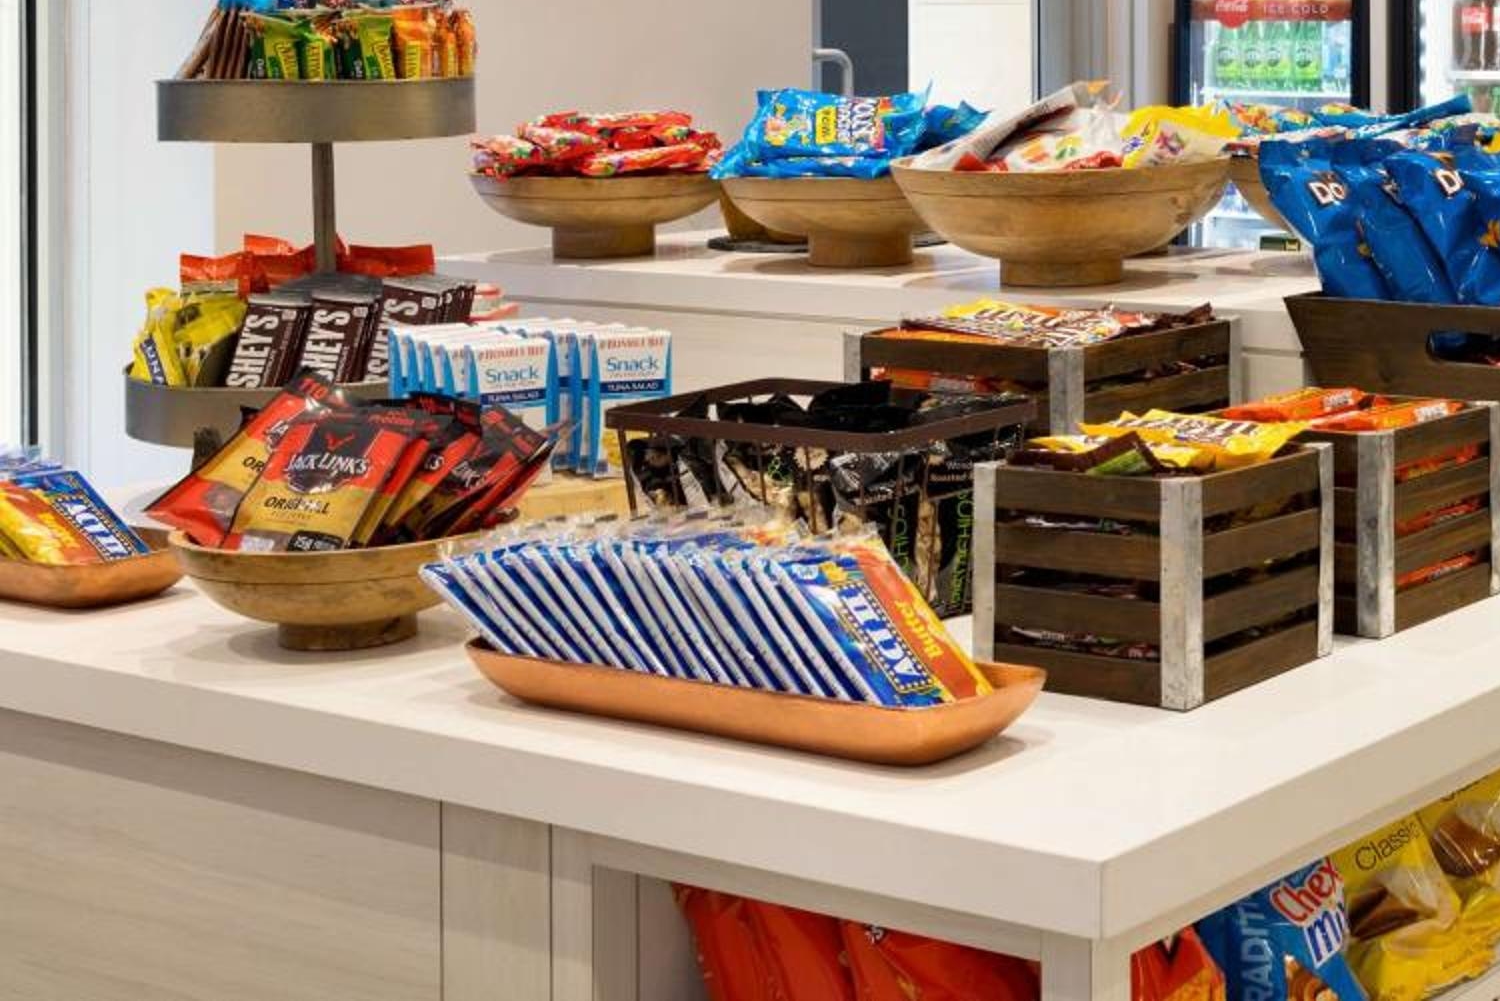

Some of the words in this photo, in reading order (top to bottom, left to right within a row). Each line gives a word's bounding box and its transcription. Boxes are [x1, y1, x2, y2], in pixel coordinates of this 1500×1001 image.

[225, 313, 279, 390] SHEY'S
[605, 354, 659, 372] Snack
[485, 366, 540, 384] Snack
[318, 451, 368, 476] LINK'S
[895, 599, 945, 659] Butter
[1269, 856, 1344, 925] Chex
